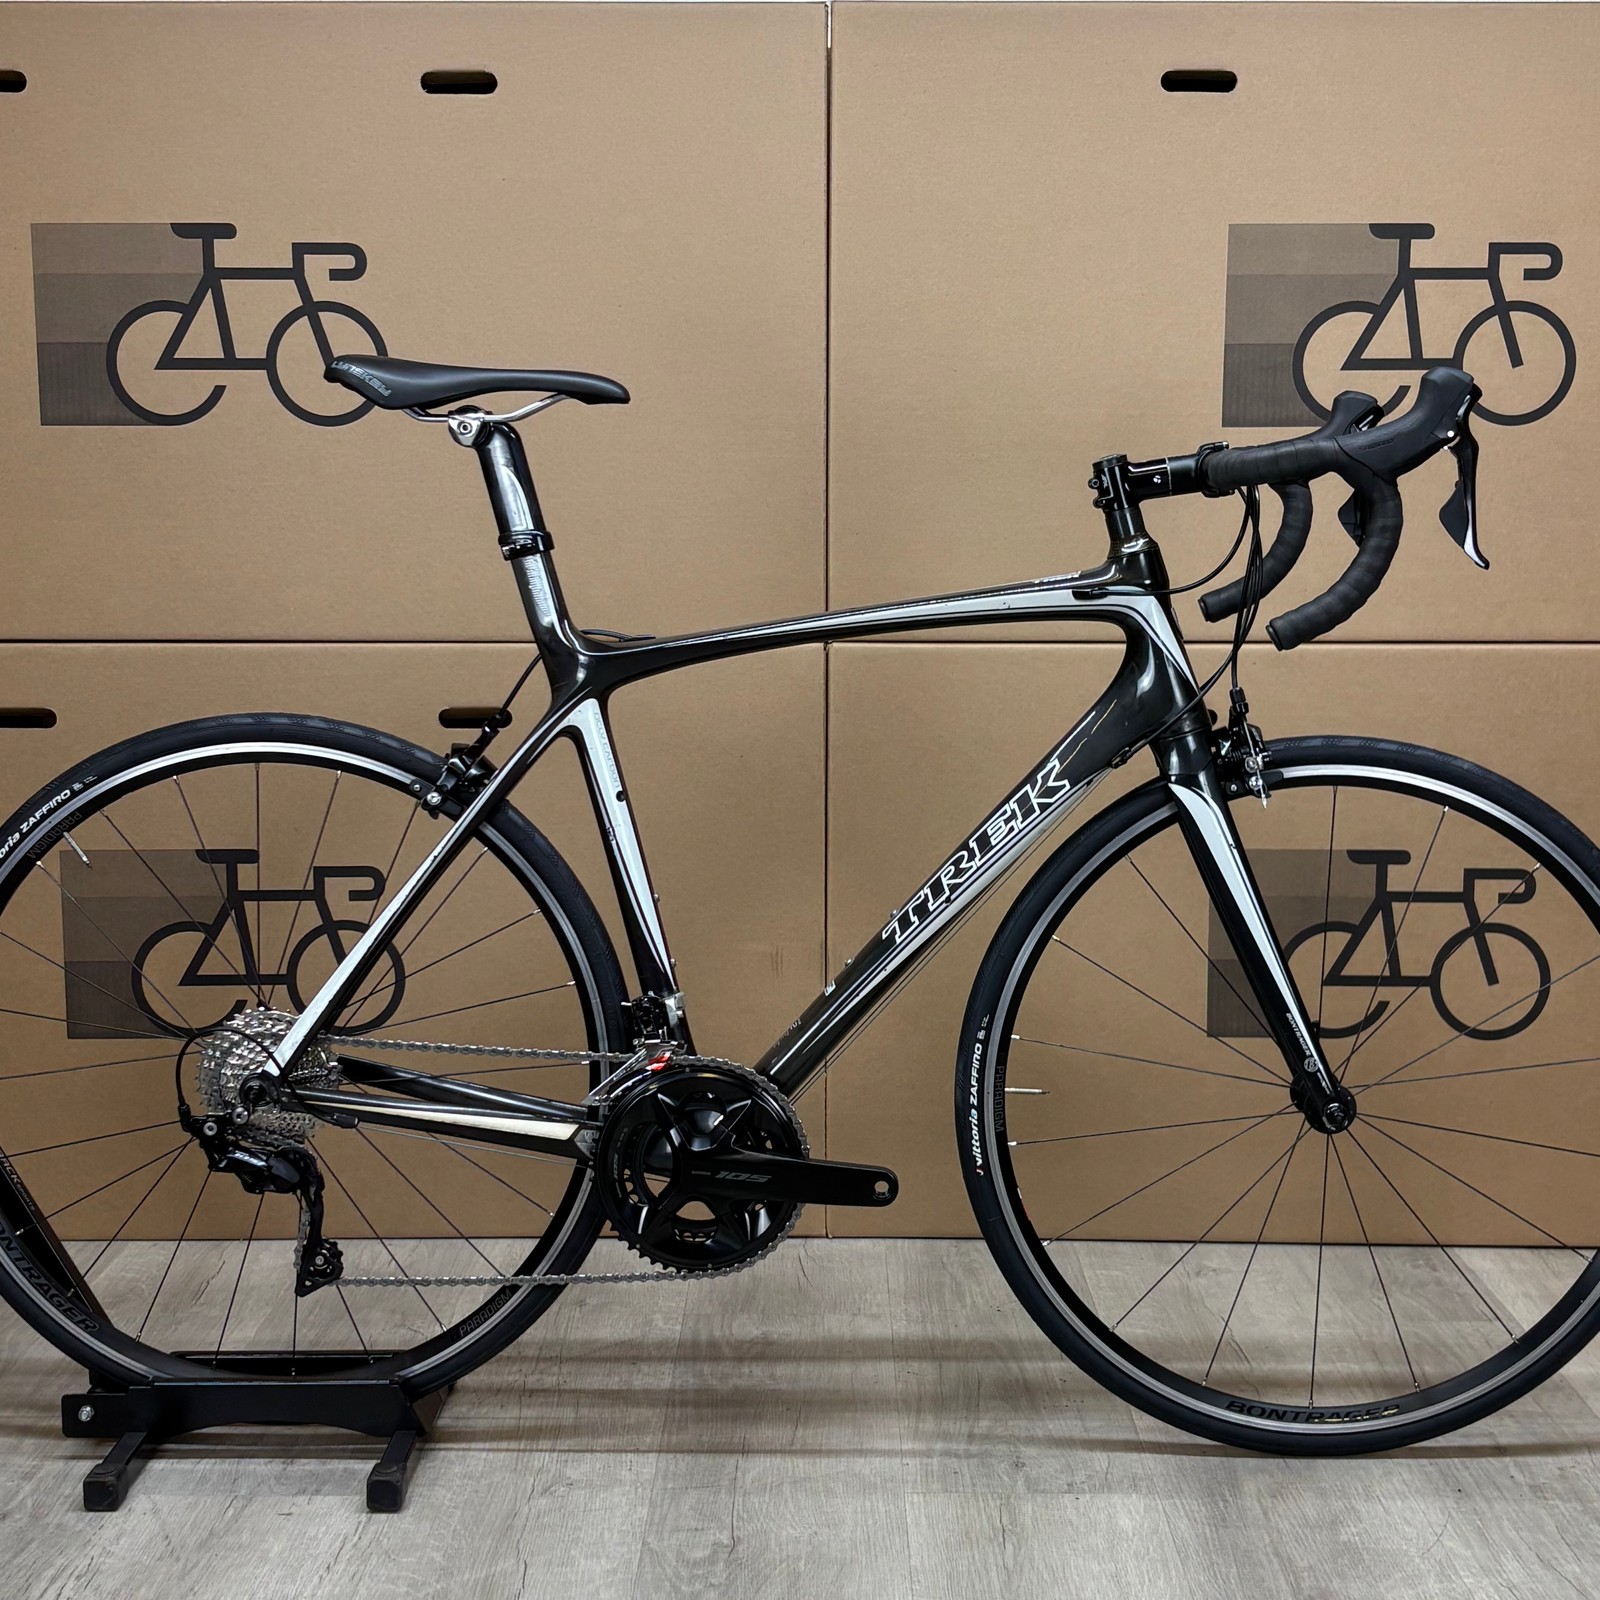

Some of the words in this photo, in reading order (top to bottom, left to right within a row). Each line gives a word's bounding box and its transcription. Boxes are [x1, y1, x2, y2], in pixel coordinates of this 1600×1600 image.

[20, 789, 71, 834] ZAFFIRO
[26, 811, 83, 859] PARADIGM
[882, 758, 1071, 944] TREK
[1285, 1012, 1312, 1057] BONTRAGER
[969, 1042, 983, 1107] ZAFFIRO
[994, 1065, 1006, 1132] PARADIGM
[968, 1108, 983, 1167] vittoria
[714, 1170, 773, 1183] 105
[459, 1288, 512, 1337] PARADIGM
[1225, 1400, 1400, 1424] BONTRAGER
